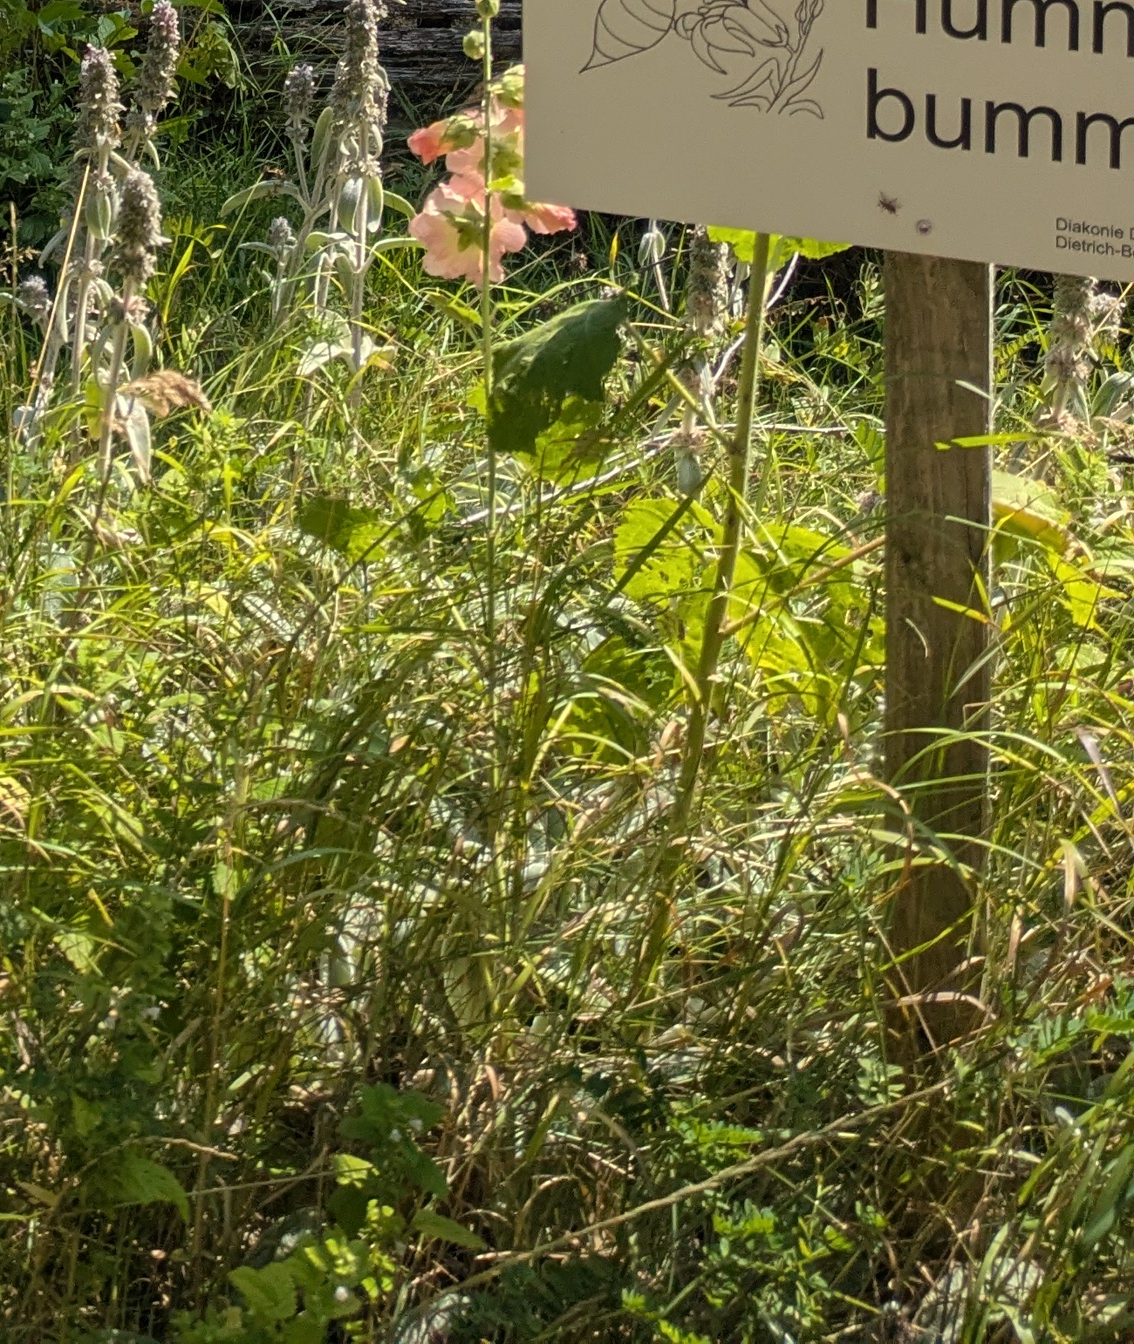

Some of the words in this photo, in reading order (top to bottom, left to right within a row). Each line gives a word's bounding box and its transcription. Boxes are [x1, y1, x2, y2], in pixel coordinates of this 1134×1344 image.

[866, 67, 1134, 170] bumm
[1055, 217, 1124, 239] Diakonie
[1055, 235, 1134, 258] Dietrich-B
